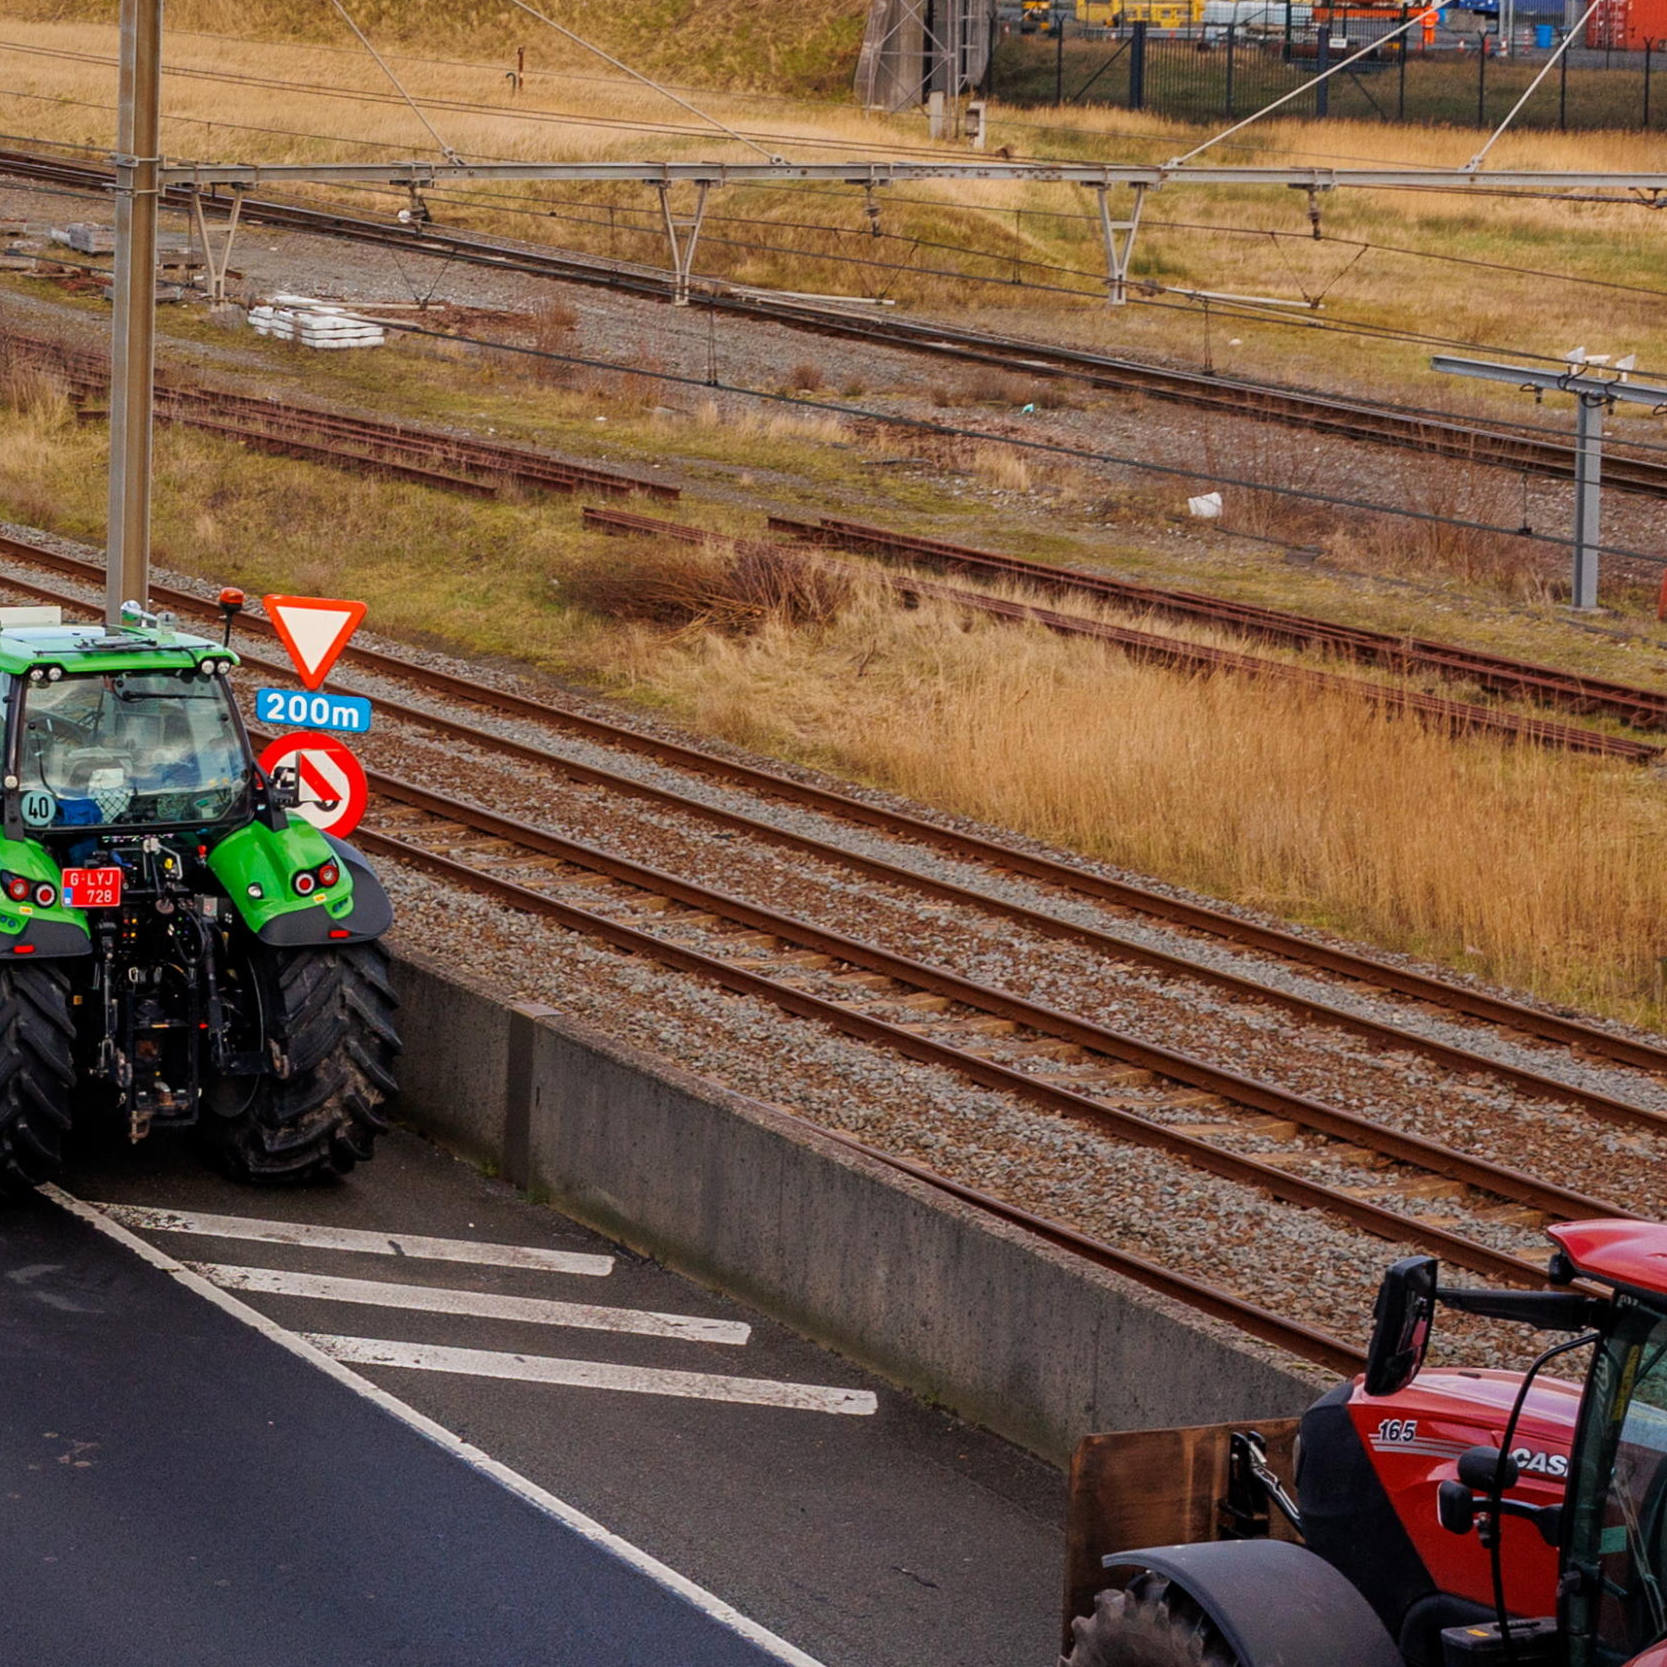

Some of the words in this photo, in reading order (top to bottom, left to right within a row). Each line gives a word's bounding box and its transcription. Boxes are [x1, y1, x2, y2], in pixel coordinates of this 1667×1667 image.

[267, 693, 359, 728] 200m
[29, 797, 49, 819] 40
[87, 890, 112, 902] 728
[1379, 1419, 1417, 1442] 165
[1512, 1448, 1567, 1477] CAS
